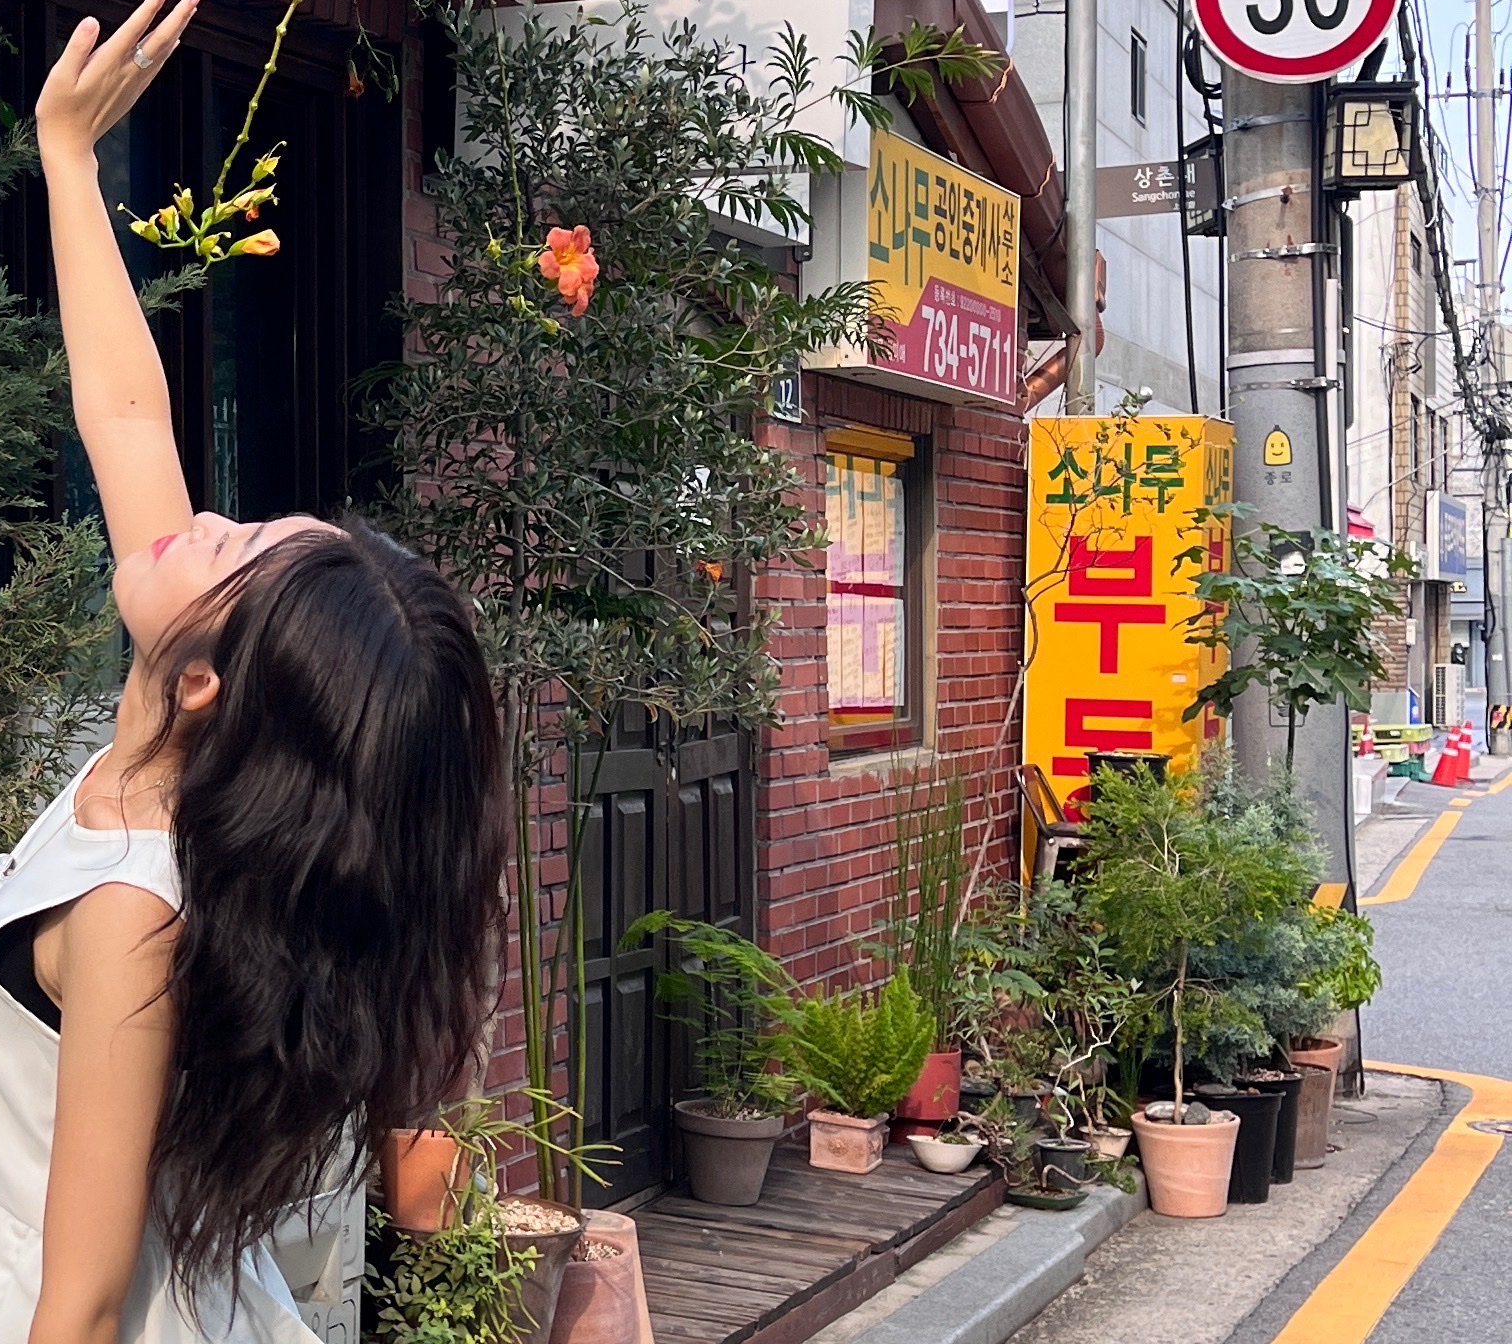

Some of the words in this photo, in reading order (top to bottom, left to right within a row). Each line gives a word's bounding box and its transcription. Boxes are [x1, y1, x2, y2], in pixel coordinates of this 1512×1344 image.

[869, 148, 931, 289] 소나무
[933, 174, 1001, 279] 공인중개사
[1000, 199, 1015, 287] 사무소
[920, 304, 1012, 396] 734-5711
[1045, 442, 1186, 514] 소나무
[1264, 470, 1293, 486] 종로
